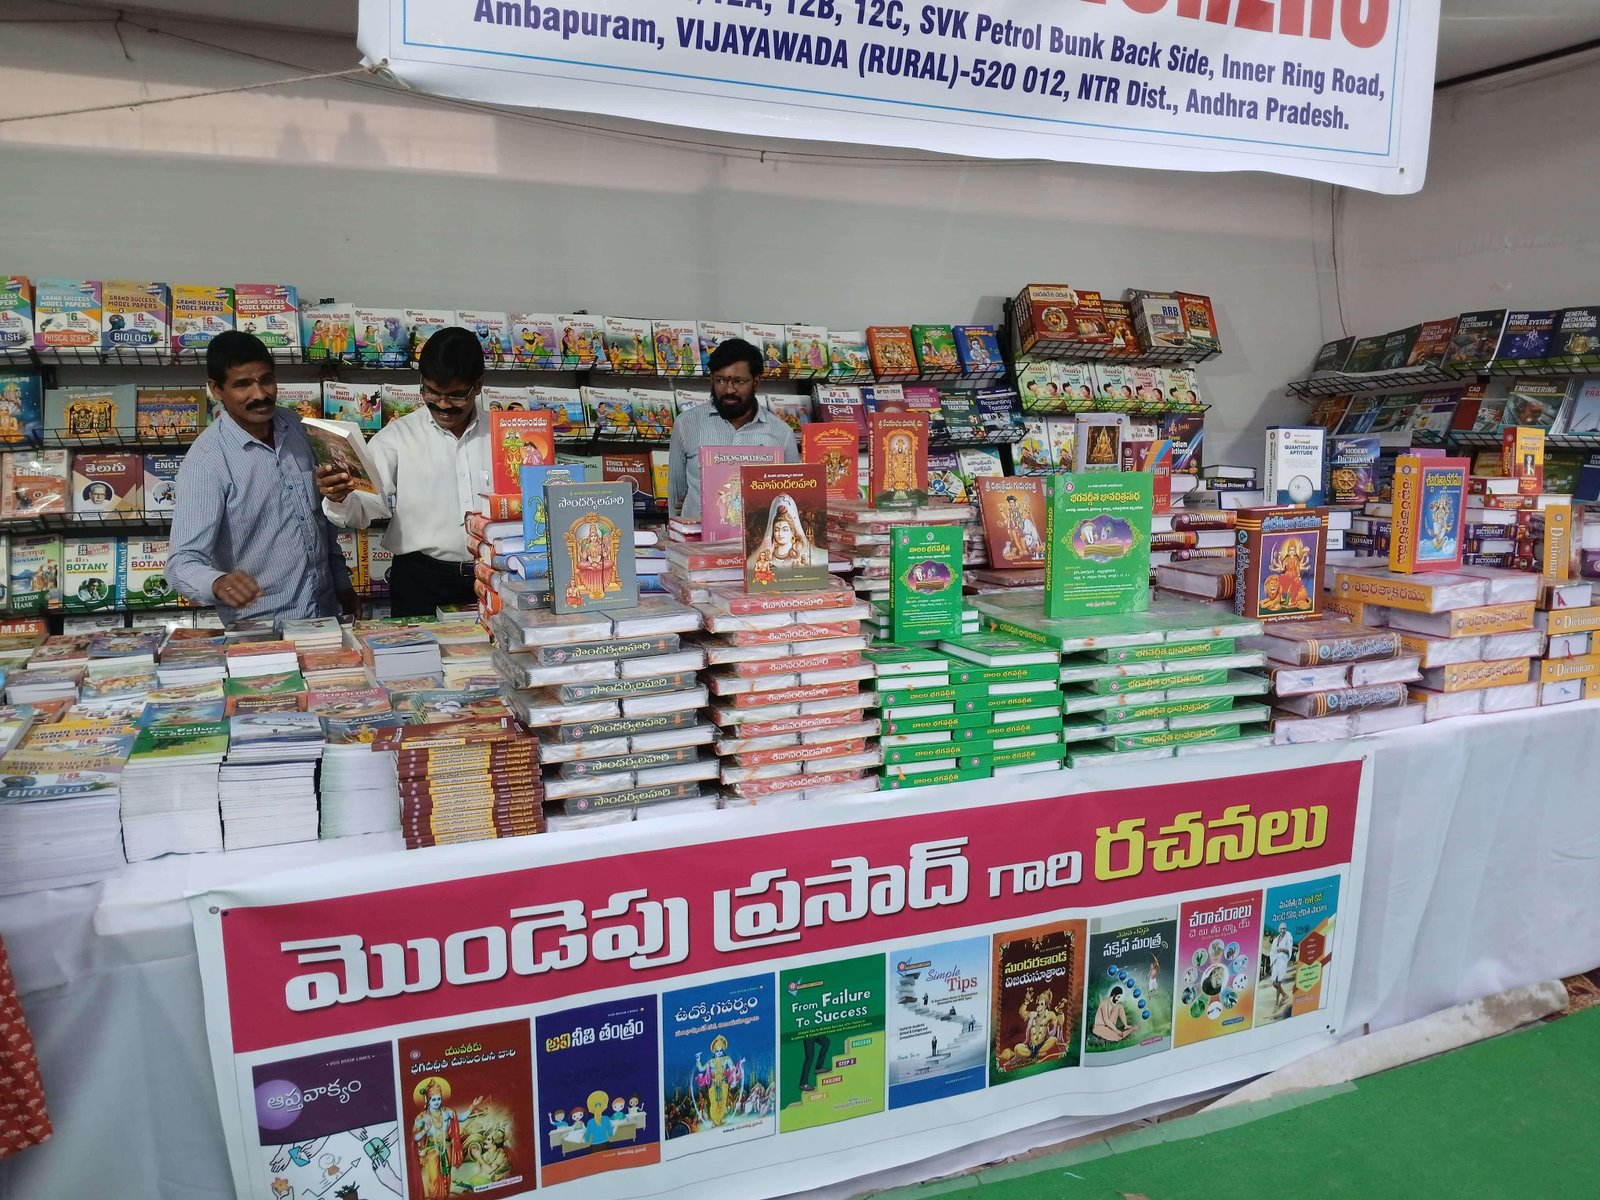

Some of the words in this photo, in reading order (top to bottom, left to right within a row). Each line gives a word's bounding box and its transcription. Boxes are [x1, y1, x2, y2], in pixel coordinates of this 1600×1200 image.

[920, 6, 966, 40] SVK
[976, 17, 1042, 51] Petrol
[1050, 27, 1104, 60] Bunk
[1112, 35, 1160, 69] Back
[1167, 41, 1214, 78] Side,
[1222, 53, 1276, 83] Inner
[1282, 61, 1325, 94] Ring
[1332, 66, 1385, 101] Road,
[474, 0, 665, 51] Ambapuram,
[676, 16, 848, 69] VIJAYAWADA
[859, 43, 1015, 91] (RURAL)-520
[1023, 66, 1068, 101] 012,
[1077, 72, 1118, 104] NTR
[1127, 81, 1179, 116] Dist.,
[1186, 88, 1257, 120] Andhra
[1266, 96, 1349, 131] Pradesh.
[1162, 306, 1178, 316] RRB
[43, 334, 69, 342] PHYSICAL
[70, 333, 91, 342] SCIENCE
[114, 332, 153, 342] BIOLOGY
[1514, 385, 1557, 393] ENGINEERING
[85, 462, 126, 472] తెలుగు
[1337, 455, 1375, 464] DICTIONARY
[1551, 527, 1563, 578] Dictionar
[66, 563, 108, 571] BOTANY
[1557, 662, 1595, 677] Dictionary
[7, 785, 95, 798] BIOLOGY
[281, 888, 688, 1012] మొండెపు
[714, 836, 968, 953] ప్రసాద్
[988, 848, 1083, 898] గారి
[1095, 803, 1329, 881] రచనలు
[1189, 904, 1252, 927] చరాచరాలు
[1103, 937, 1130, 958] సక్సెస్
[1132, 932, 1163, 952] మంత్ర
[1005, 950, 1067, 974] సుందరకాండ
[926, 964, 961, 983] Simple
[947, 975, 978, 993] Tips
[1005, 965, 1066, 987] విజయసూత్రాలు
[674, 996, 758, 1023] ఉద్యోగపర్వం
[791, 1001, 818, 1013] From
[822, 988, 871, 1008] Failure
[796, 1017, 810, 1028] To
[814, 1005, 868, 1025] Success
[599, 1019, 644, 1042] తంత్రం
[444, 1041, 483, 1057] యువతకు
[267, 1078, 362, 1112] ఆప్తవాక్యం
